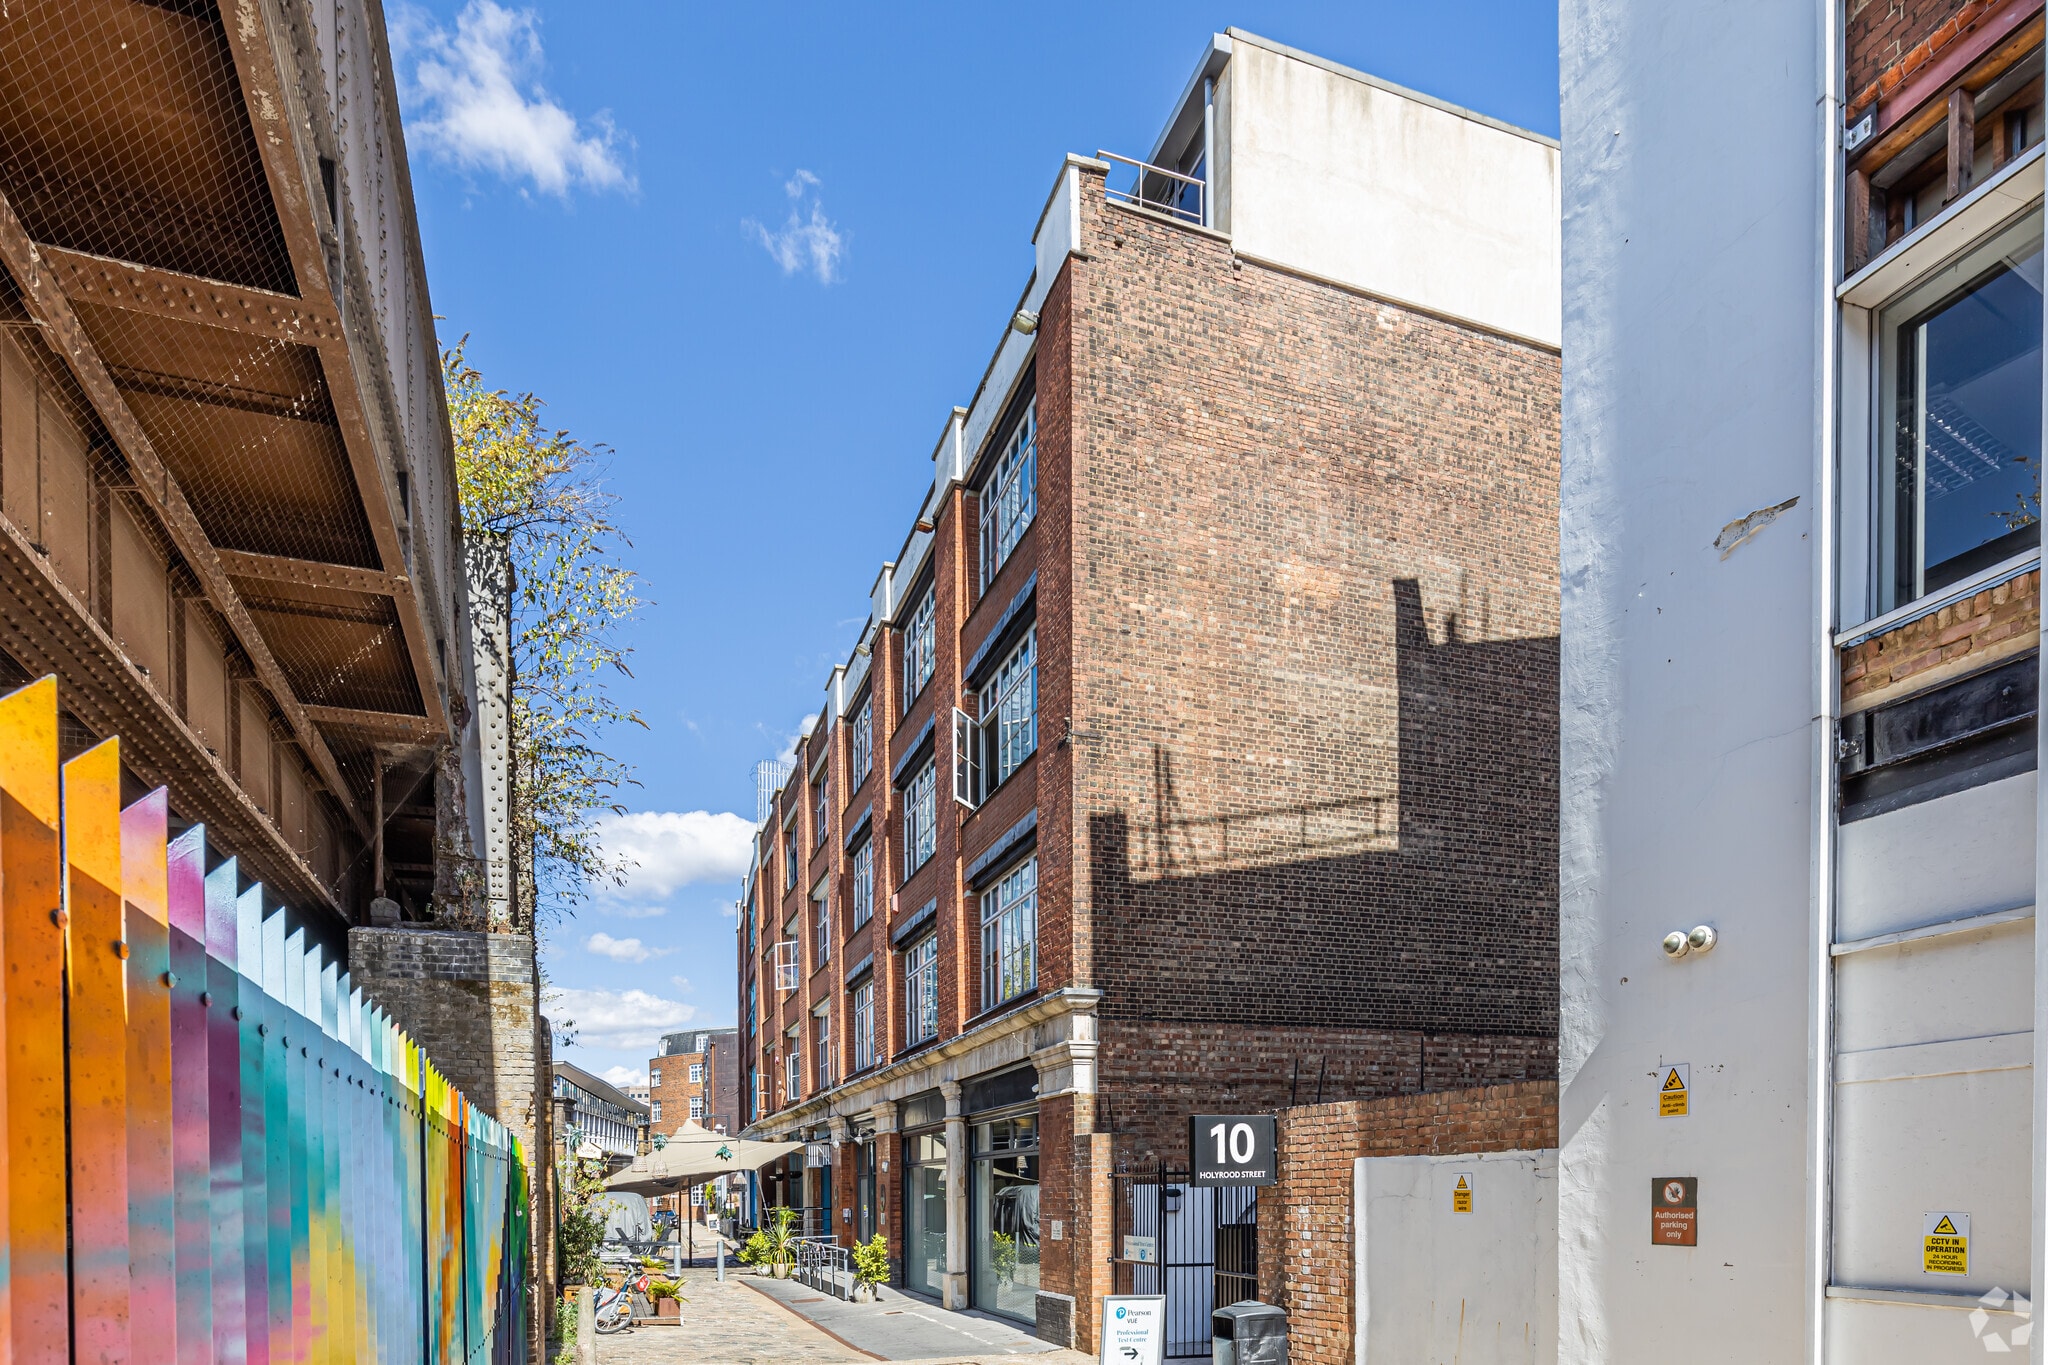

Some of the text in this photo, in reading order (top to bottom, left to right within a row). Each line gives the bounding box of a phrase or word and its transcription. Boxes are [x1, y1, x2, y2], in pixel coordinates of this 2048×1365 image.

[1210, 1122, 1255, 1164] 10
[1199, 1170, 1266, 1179] HOLYROOD STREET
[1655, 1211, 1694, 1219] Authorised
[1660, 1221, 1688, 1230] parking
[1666, 1231, 1681, 1239] only
[1931, 1237, 1950, 1245] CCTV
[1926, 1245, 1965, 1253] OPERATION
